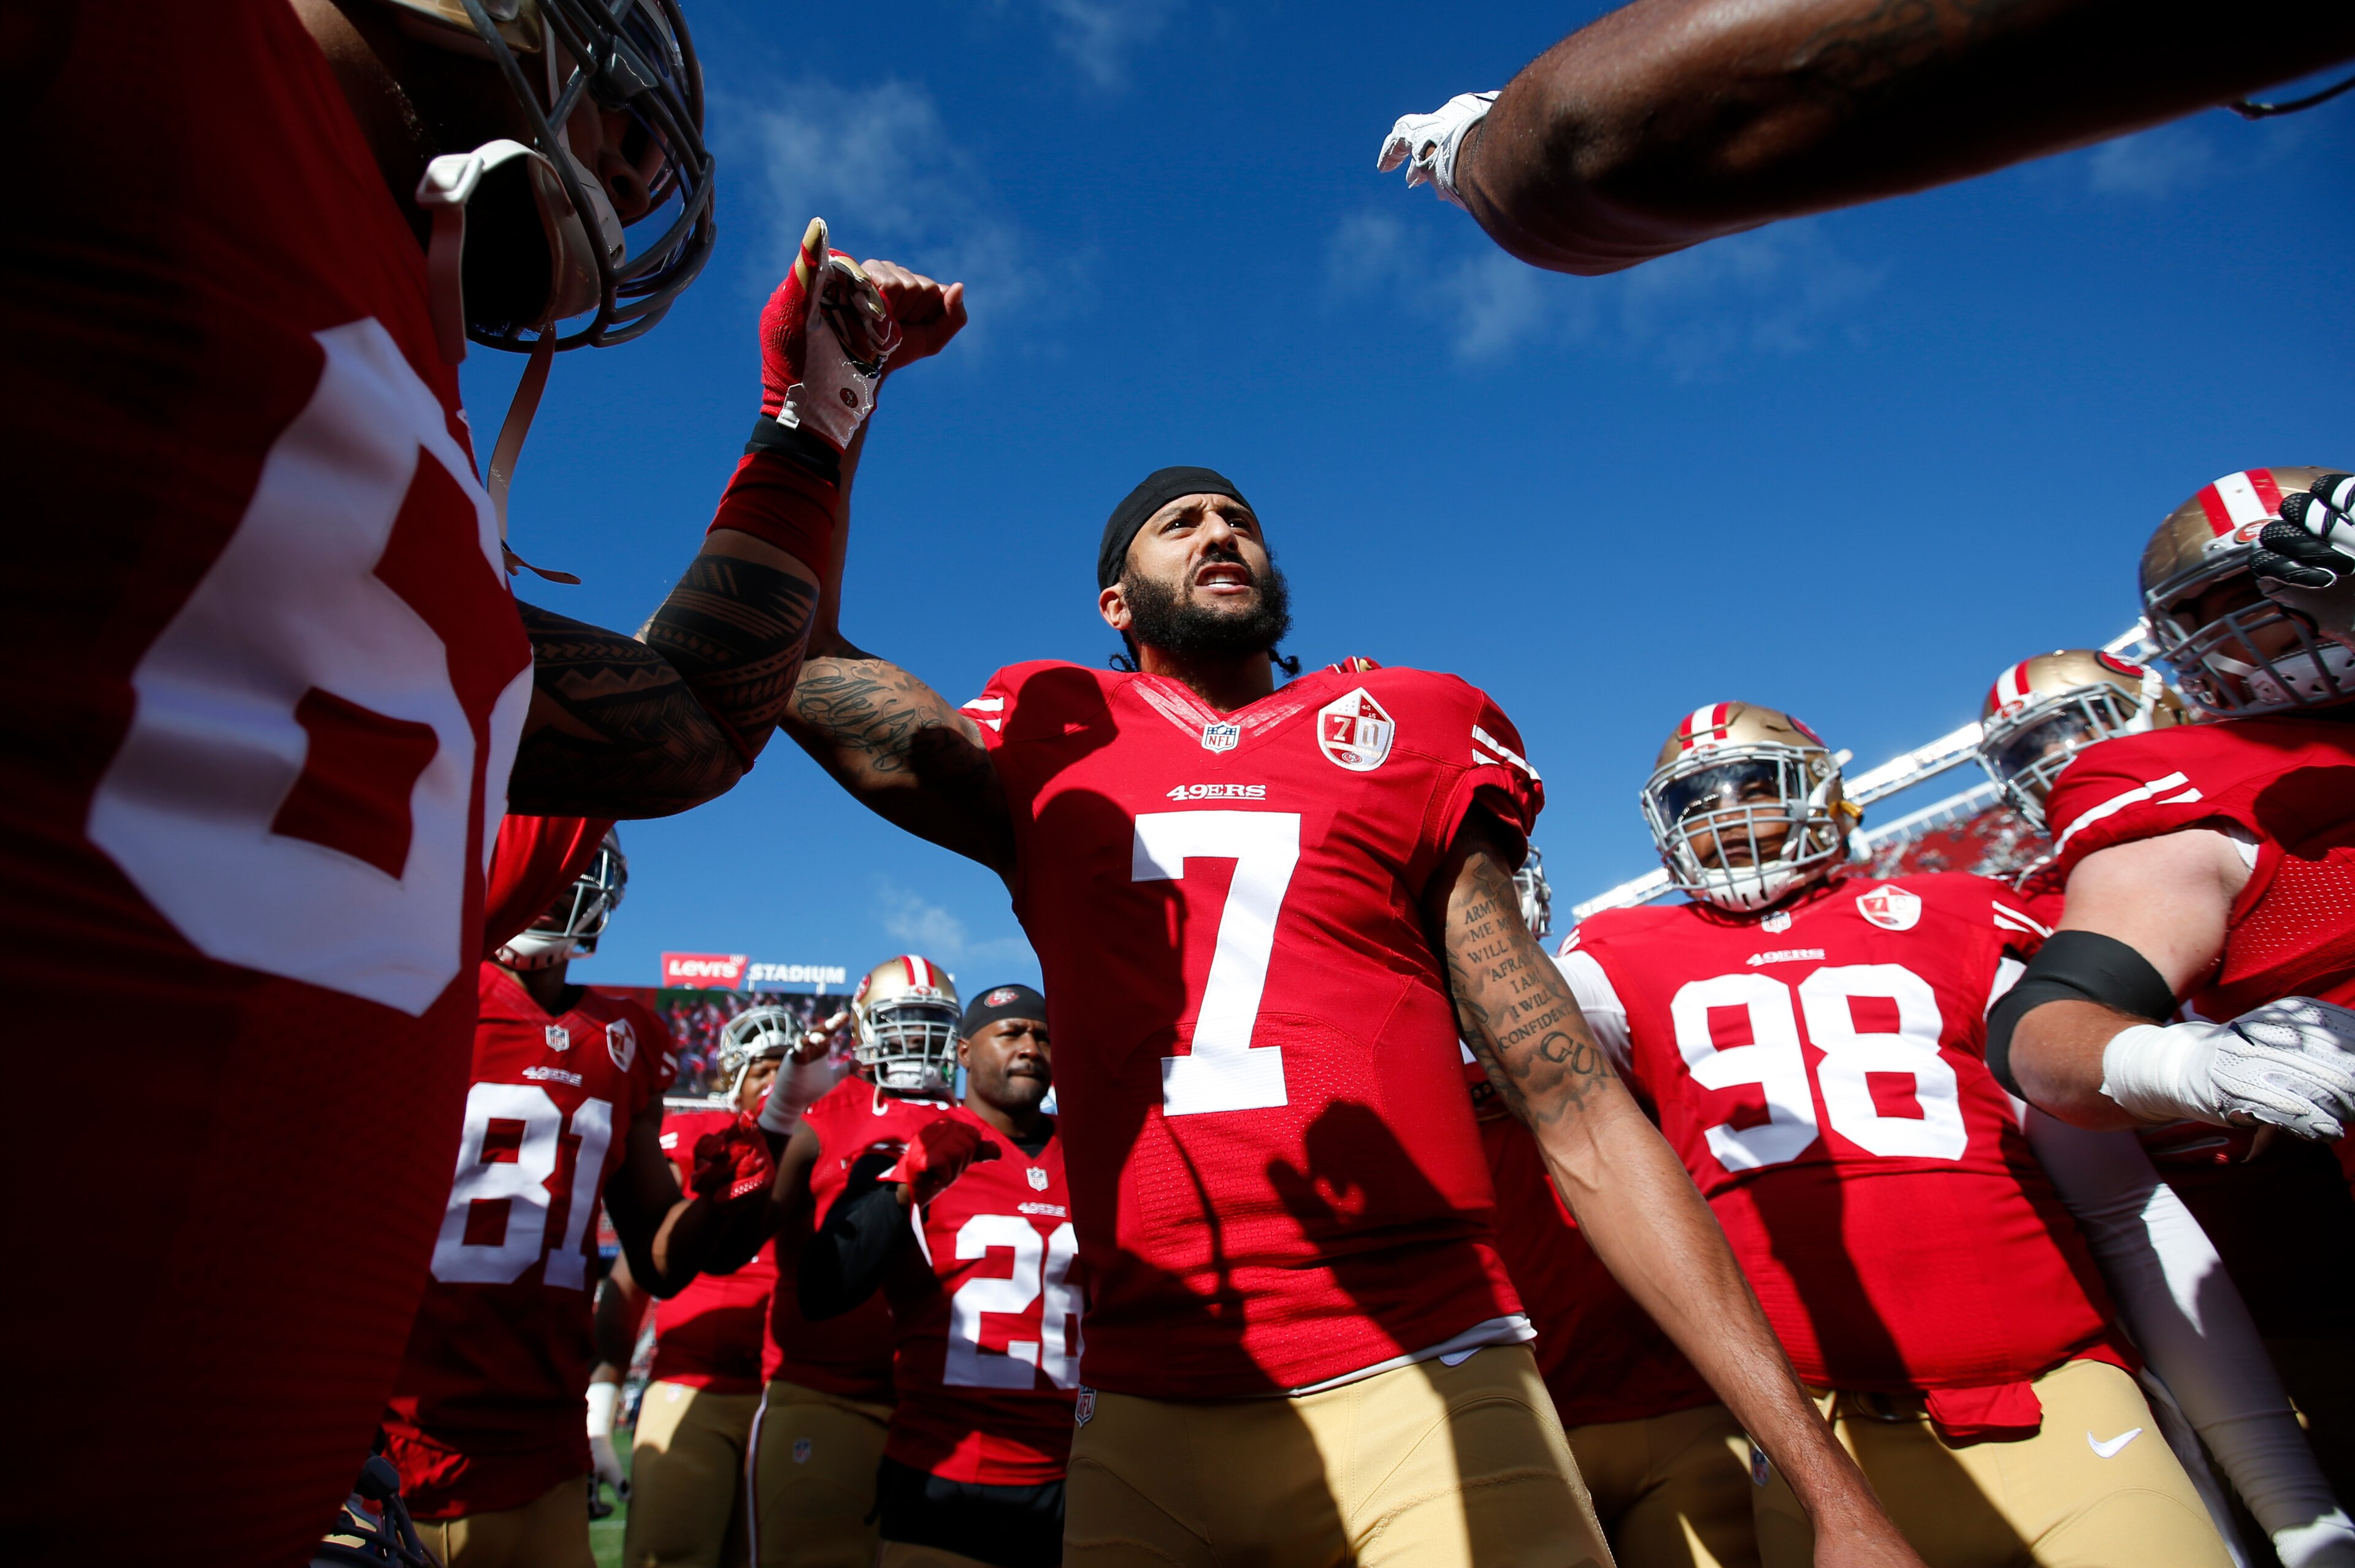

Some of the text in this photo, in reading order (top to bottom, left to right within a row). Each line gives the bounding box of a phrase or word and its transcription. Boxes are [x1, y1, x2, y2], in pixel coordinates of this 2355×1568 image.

[1208, 735, 1232, 747] NFL
[1333, 716, 1379, 748] 70
[1165, 784, 1266, 801] 49ERS
[1463, 898, 1498, 925] ARMY
[1469, 922, 1495, 943] ME
[1132, 810, 1301, 1116] 7
[1467, 939, 1509, 964] WILL
[1746, 949, 1826, 966] 49ERS
[748, 963, 846, 984] STADIUM
[1509, 969, 1541, 994] I AM
[1511, 989, 1553, 1019] I WILL
[1670, 963, 1969, 1172] 98
[430, 1082, 613, 1291] 81
[943, 1214, 1085, 1390] 26
